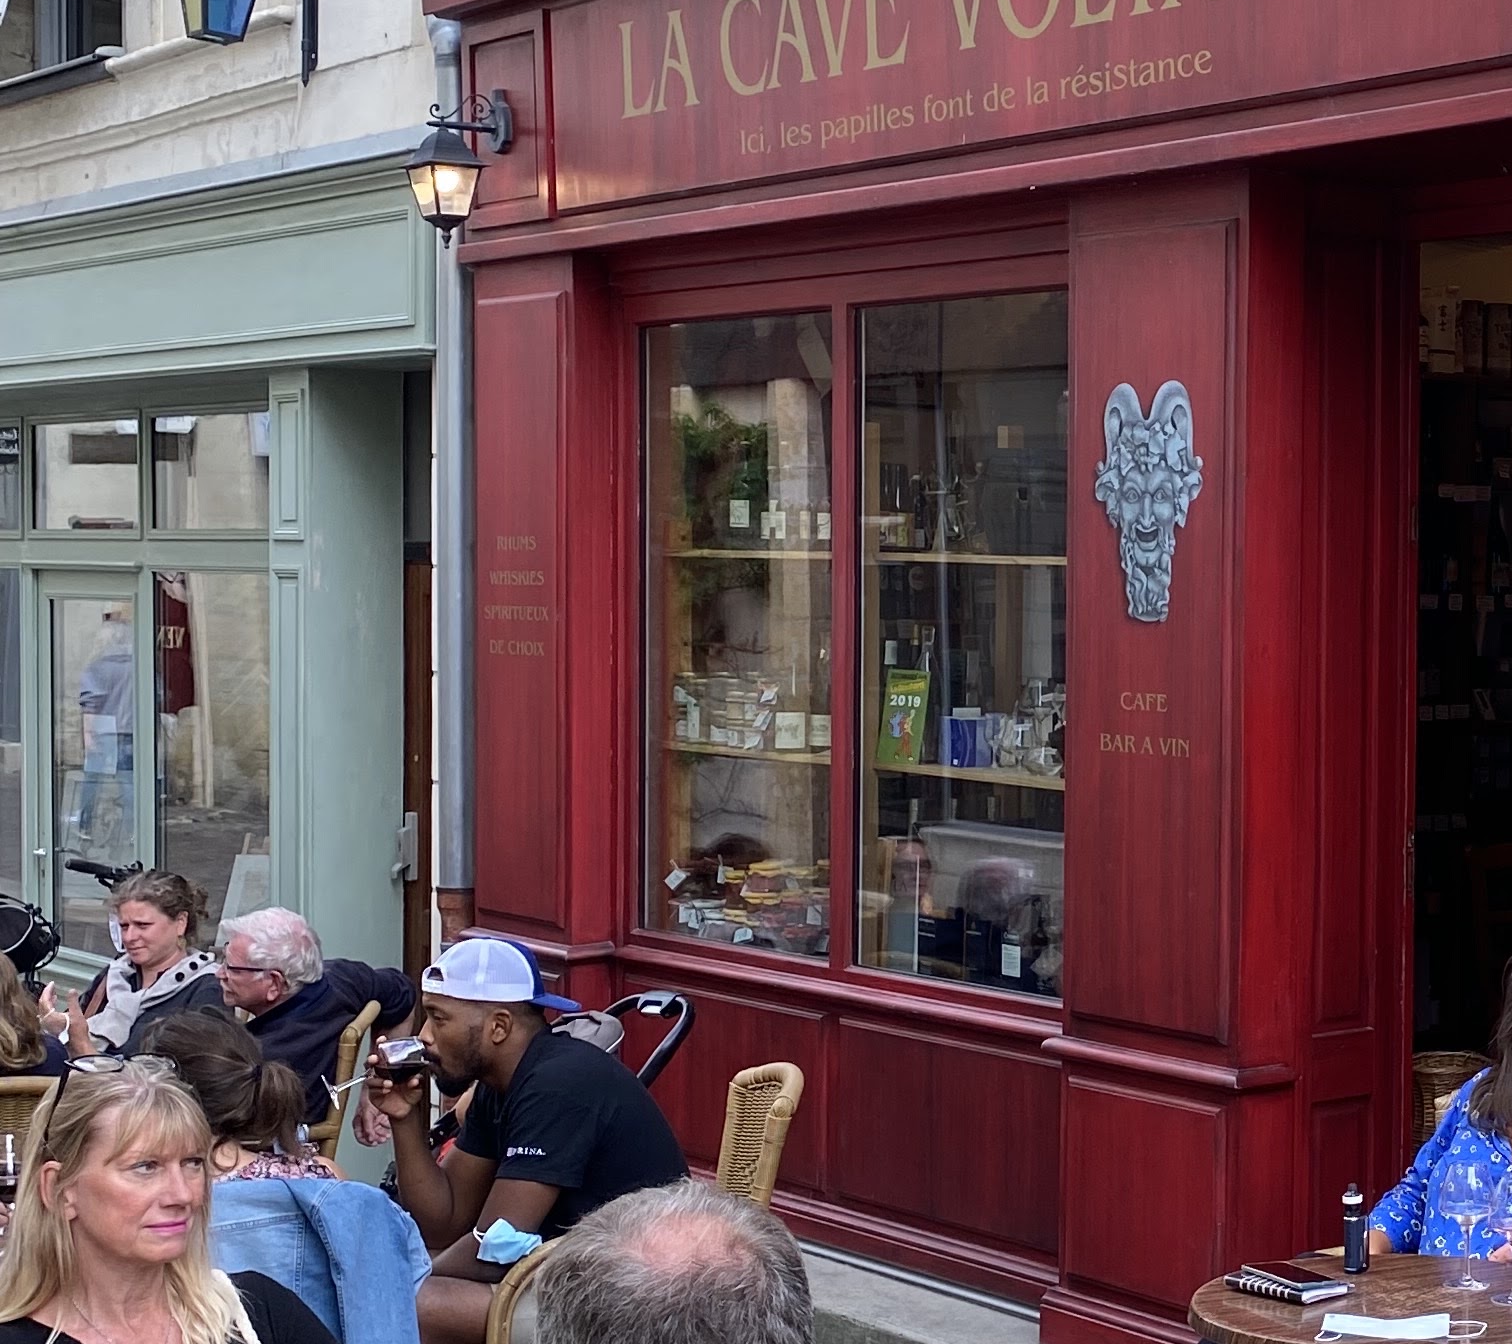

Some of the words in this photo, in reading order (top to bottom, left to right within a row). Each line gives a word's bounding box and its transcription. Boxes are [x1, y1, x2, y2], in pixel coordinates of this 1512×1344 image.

[618, 9, 701, 120] LA
[779, 119, 813, 149] les
[820, 102, 915, 162] papilles
[922, 92, 976, 125] font
[982, 81, 1017, 114] de
[1025, 75, 1051, 105] la
[1058, 49, 1214, 100] résistance
[496, 536, 537, 551] RHUMS
[489, 570, 545, 586] WHISKIES
[484, 604, 549, 622] SPIRITUEUX
[489, 639, 506, 654] DE
[508, 640, 545, 656] CHOIX
[889, 693, 922, 709] 2019
[1120, 691, 1168, 712] CAFE
[1100, 733, 1136, 754] BAR
[1140, 736, 1154, 755] A
[1159, 737, 1190, 758] VIN
